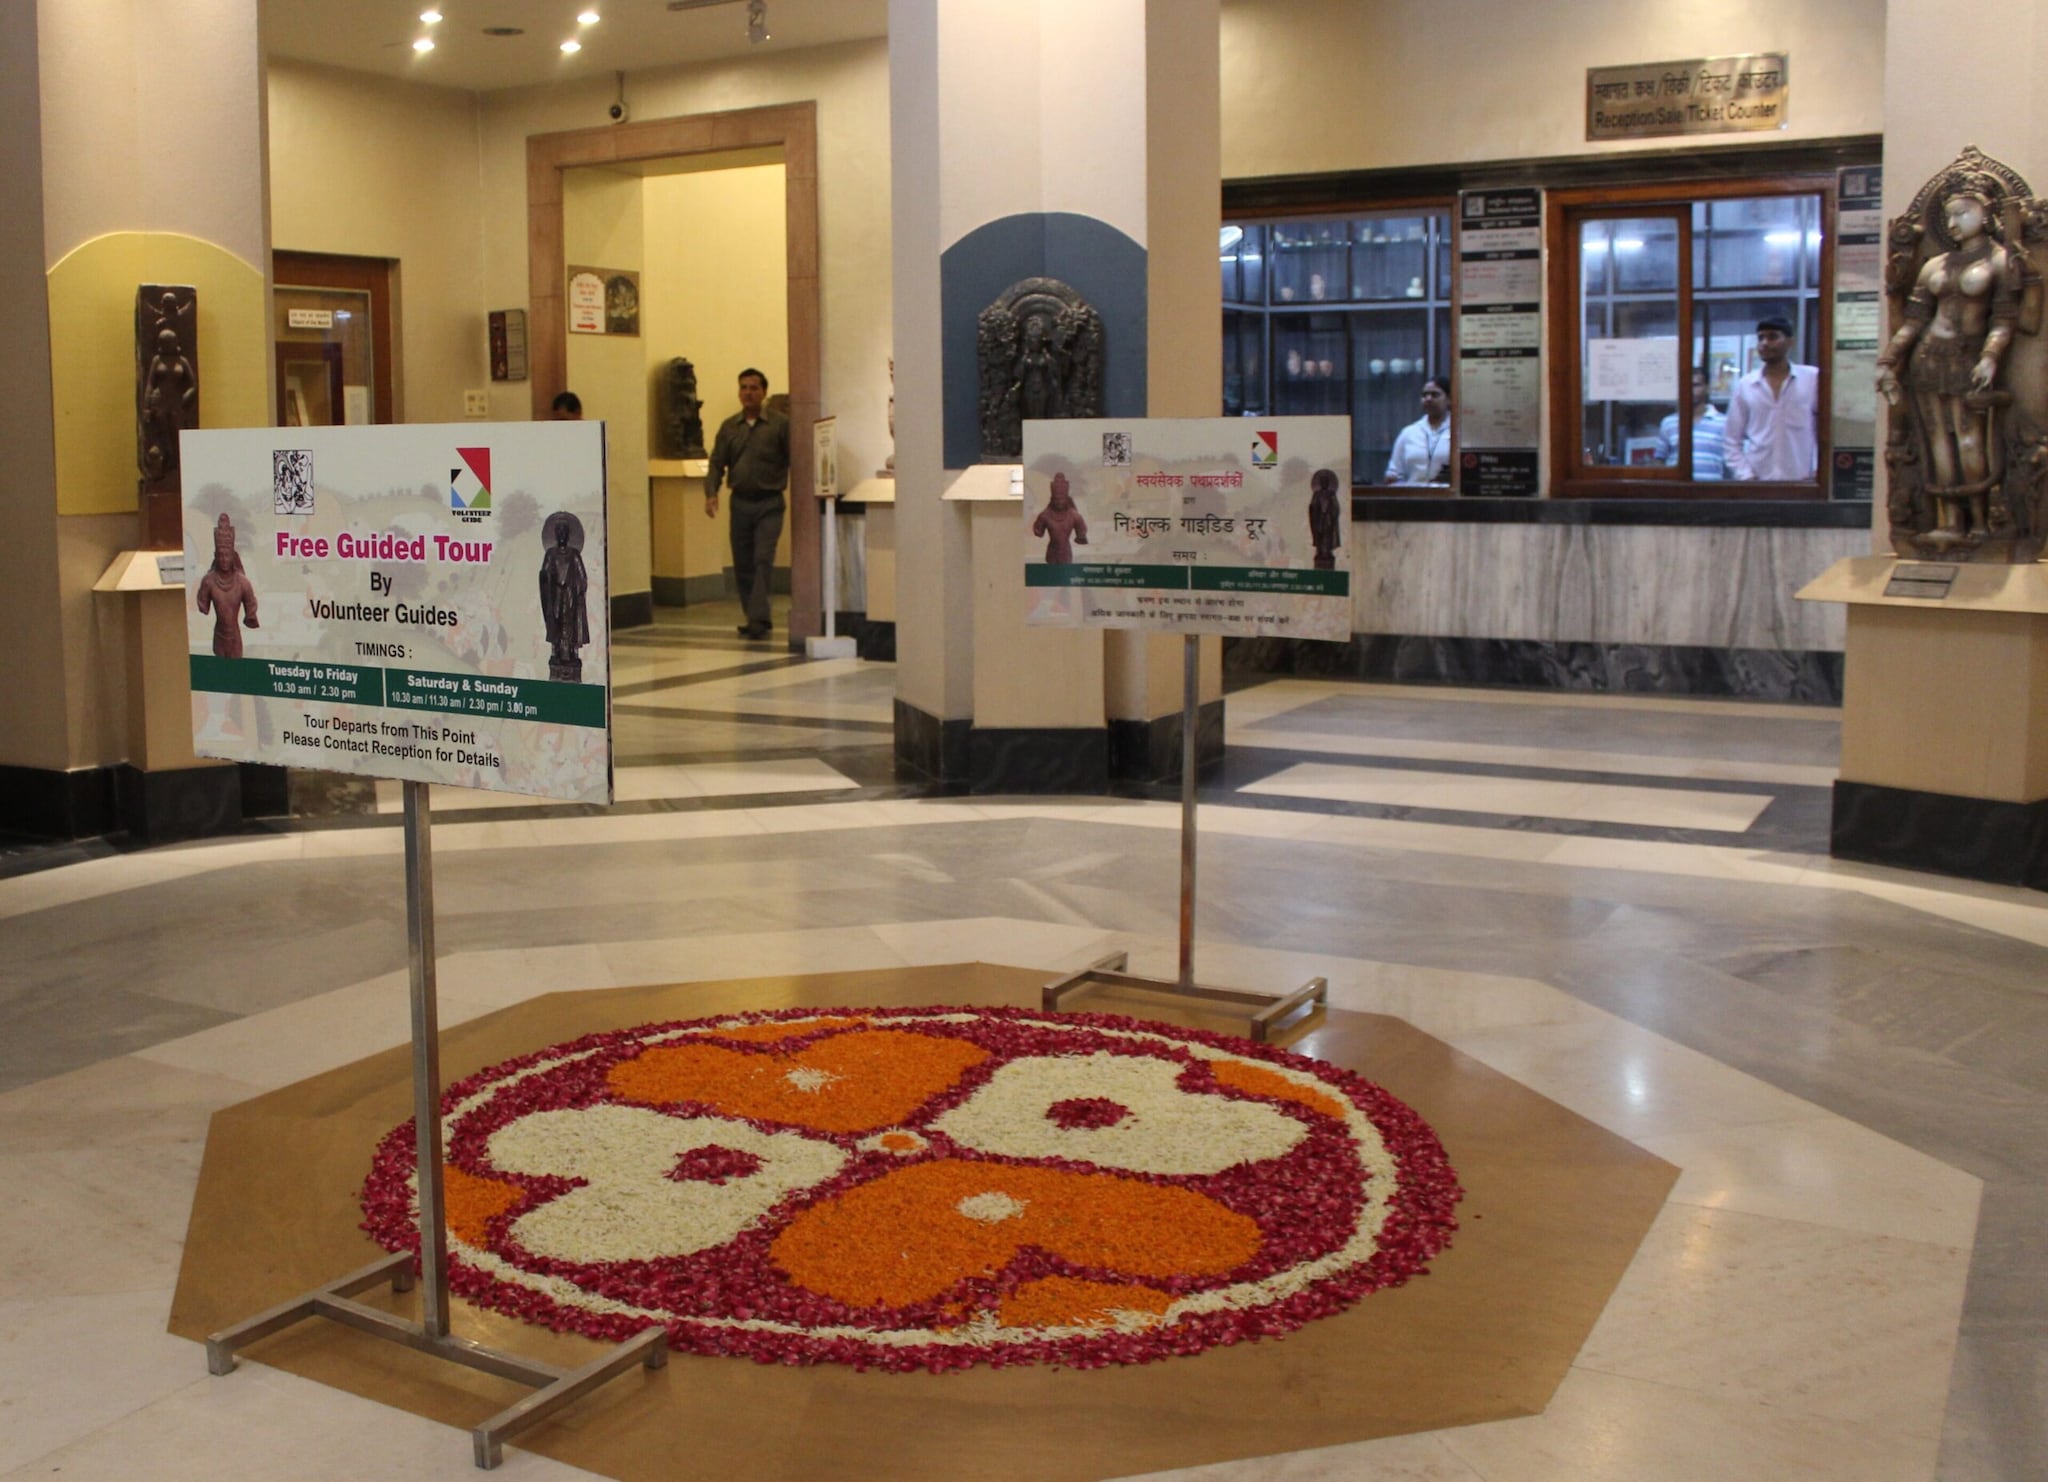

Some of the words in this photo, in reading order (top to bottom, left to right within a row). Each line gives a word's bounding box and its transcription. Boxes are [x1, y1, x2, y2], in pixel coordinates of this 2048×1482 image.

[1728, 101, 1777, 120] Counter
[1136, 471, 1184, 488] स्वयंसेवक
[1113, 512, 1171, 538] निःशुल्क
[1180, 513, 1235, 536] गाइडिड
[1245, 518, 1267, 540] टूर
[276, 532, 329, 558] Free
[336, 533, 425, 561] Guided
[433, 535, 493, 562] Tour
[1172, 551, 1197, 561] समय
[370, 572, 392, 597] By
[310, 599, 390, 623] Volunteer
[395, 603, 458, 627] Guides
[355, 642, 405, 659] TIMINGS
[268, 664, 311, 681] Tuesday
[313, 667, 324, 679] to
[326, 668, 358, 685] Friday
[407, 675, 459, 693] Saturday
[462, 679, 471, 691] &
[474, 681, 519, 698] Sunday
[273, 682, 296, 693] 10.30
[297, 686, 312, 695] am
[321, 685, 340, 697] 2.30
[342, 689, 356, 700] pm
[392, 691, 411, 703] 10.30
[412, 695, 424, 705] am
[429, 694, 448, 706] 11.30
[450, 698, 462, 708] am
[469, 698, 485, 710] 2.30
[487, 702, 499, 713] pm
[524, 705, 538, 717] pm
[304, 714, 330, 729] Tour
[333, 717, 378, 735] Departs
[381, 722, 409, 738] from
[412, 725, 438, 741] This
[442, 728, 475, 745] Point
[283, 731, 321, 747] Please
[324, 735, 368, 753] Contact
[372, 740, 432, 760] Reception
[436, 747, 453, 762] for
[457, 749, 500, 768] Details
